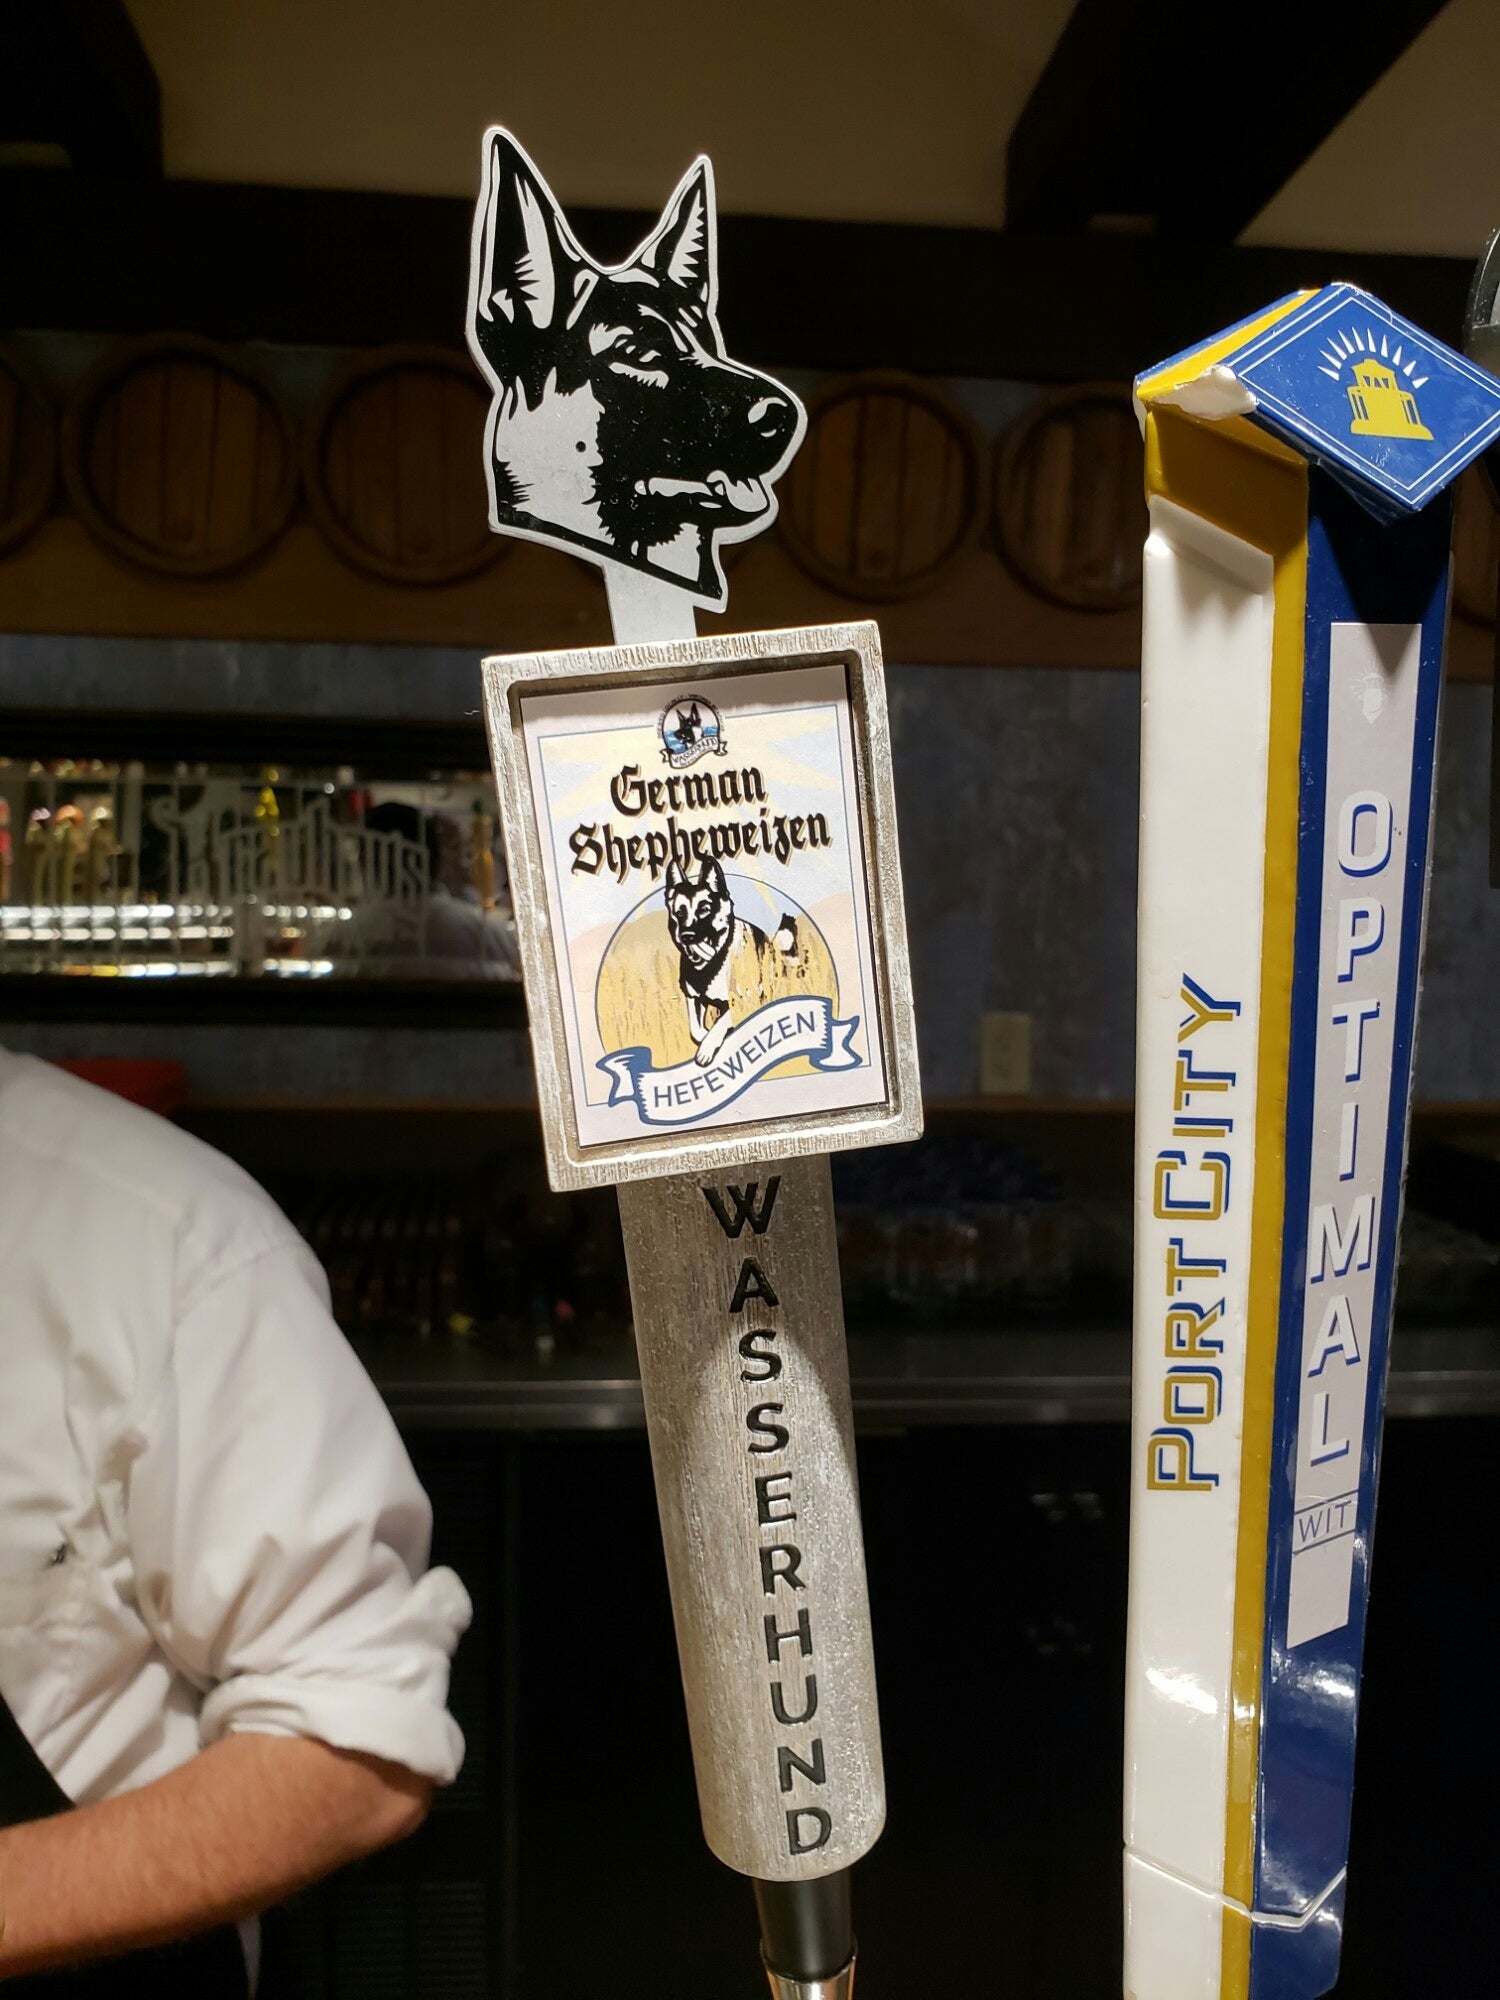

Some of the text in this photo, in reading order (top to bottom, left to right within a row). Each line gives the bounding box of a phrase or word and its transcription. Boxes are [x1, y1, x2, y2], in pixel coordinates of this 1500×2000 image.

[610, 763, 768, 817] German
[569, 808, 832, 884] Shepheweizen
[654, 1010, 817, 1109] HEFEWEIZEN
[1307, 790, 1394, 1468] OPTIMAL
[1147, 972, 1241, 1491] PORT CITY
[703, 1174, 833, 1856] WASSERHUND
[1298, 1500, 1353, 1544] WIT
